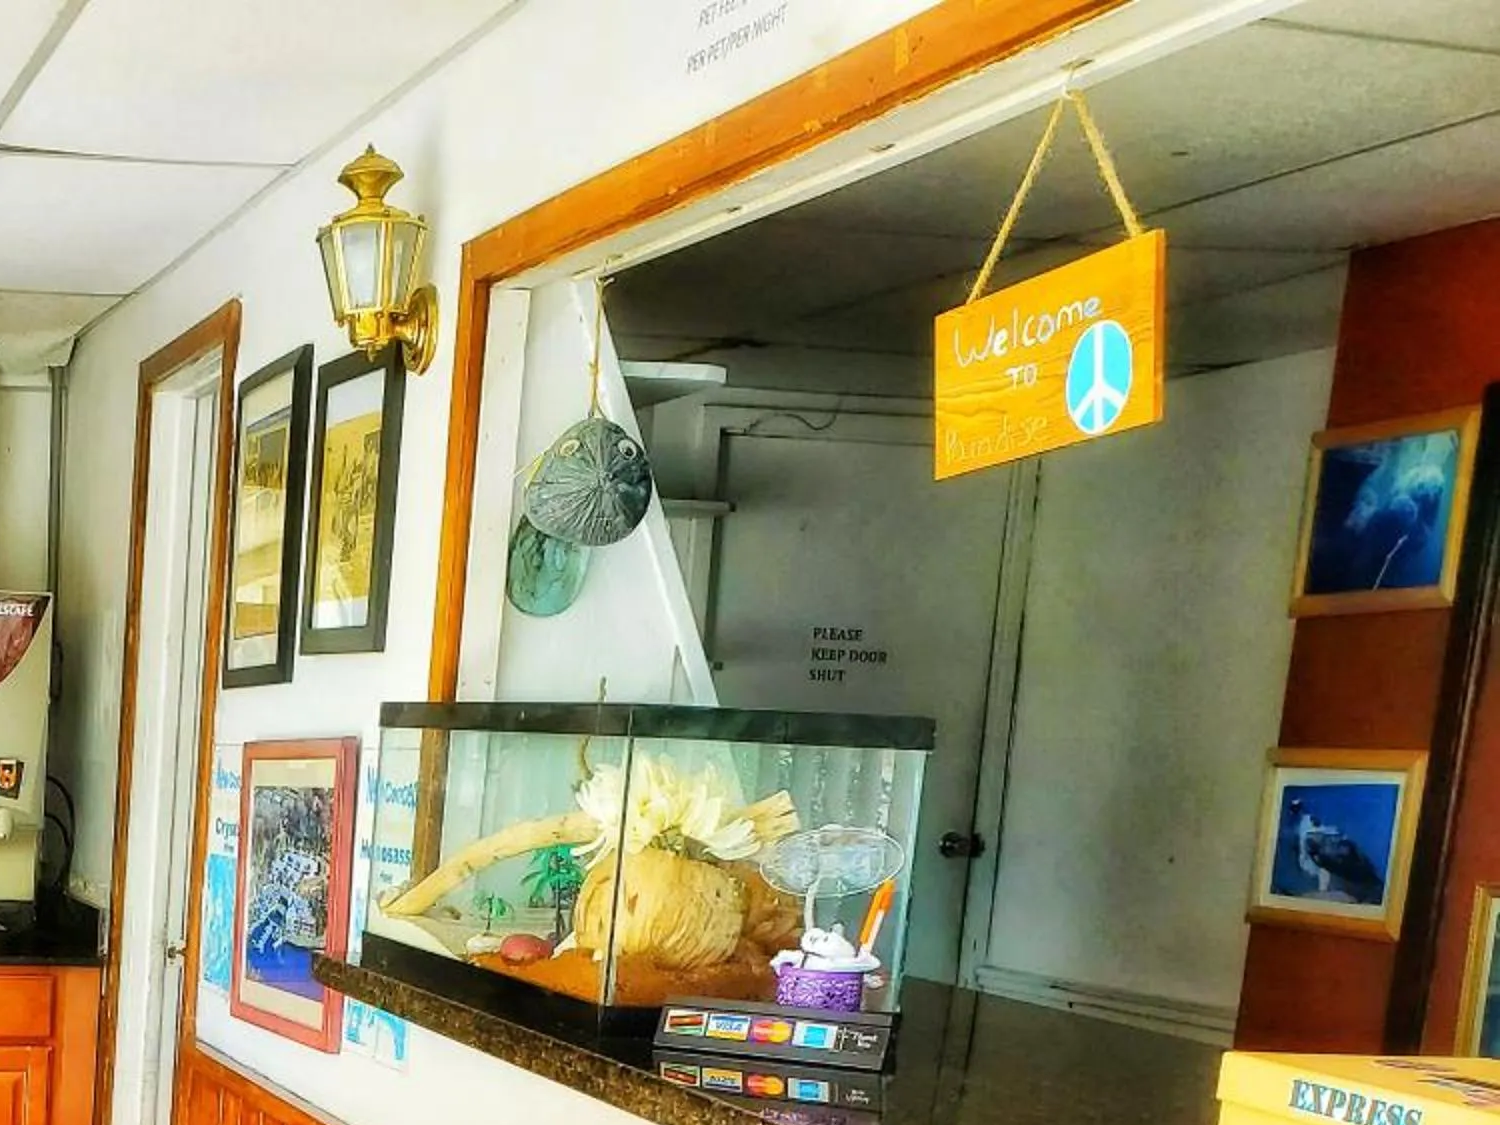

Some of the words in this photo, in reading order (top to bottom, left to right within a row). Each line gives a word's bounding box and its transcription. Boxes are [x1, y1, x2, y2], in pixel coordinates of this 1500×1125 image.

[953, 296, 1102, 368] Welcome
[812, 626, 863, 641] PLEASE
[811, 647, 846, 661] KEEP
[848, 649, 888, 664] DOOR
[808, 668, 846, 682] SHUT
